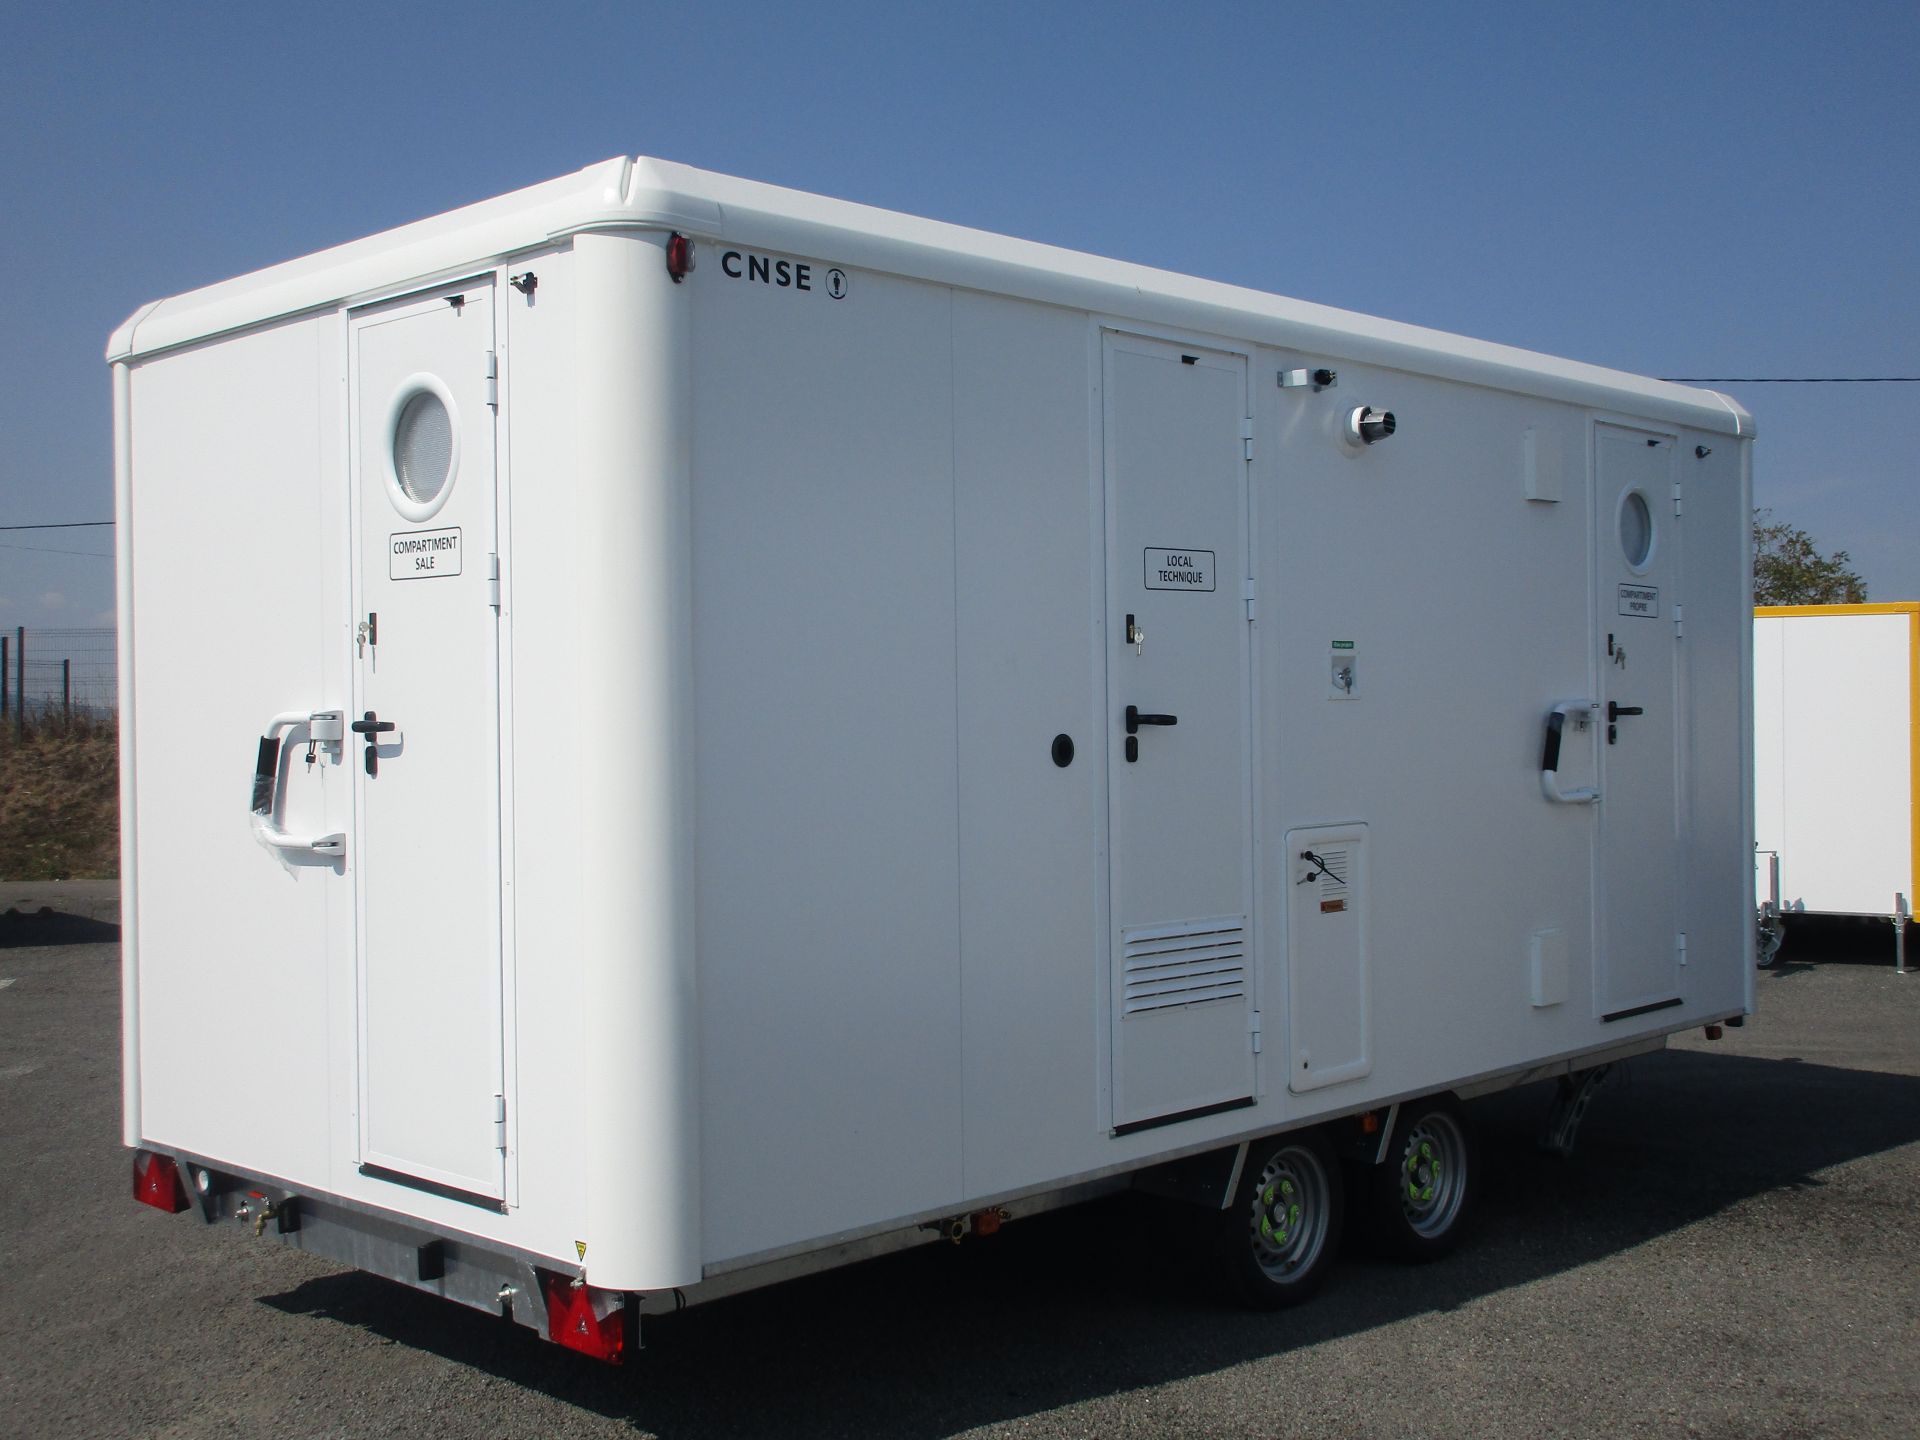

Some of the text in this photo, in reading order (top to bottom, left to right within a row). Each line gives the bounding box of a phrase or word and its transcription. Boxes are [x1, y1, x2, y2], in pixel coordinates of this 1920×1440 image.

[721, 251, 811, 291] CNSE
[393, 536, 458, 554] COMPARTIMENT
[415, 556, 435, 570] SALE
[1167, 555, 1193, 567] LOCAL
[1158, 570, 1203, 584] TECHNIQUE
